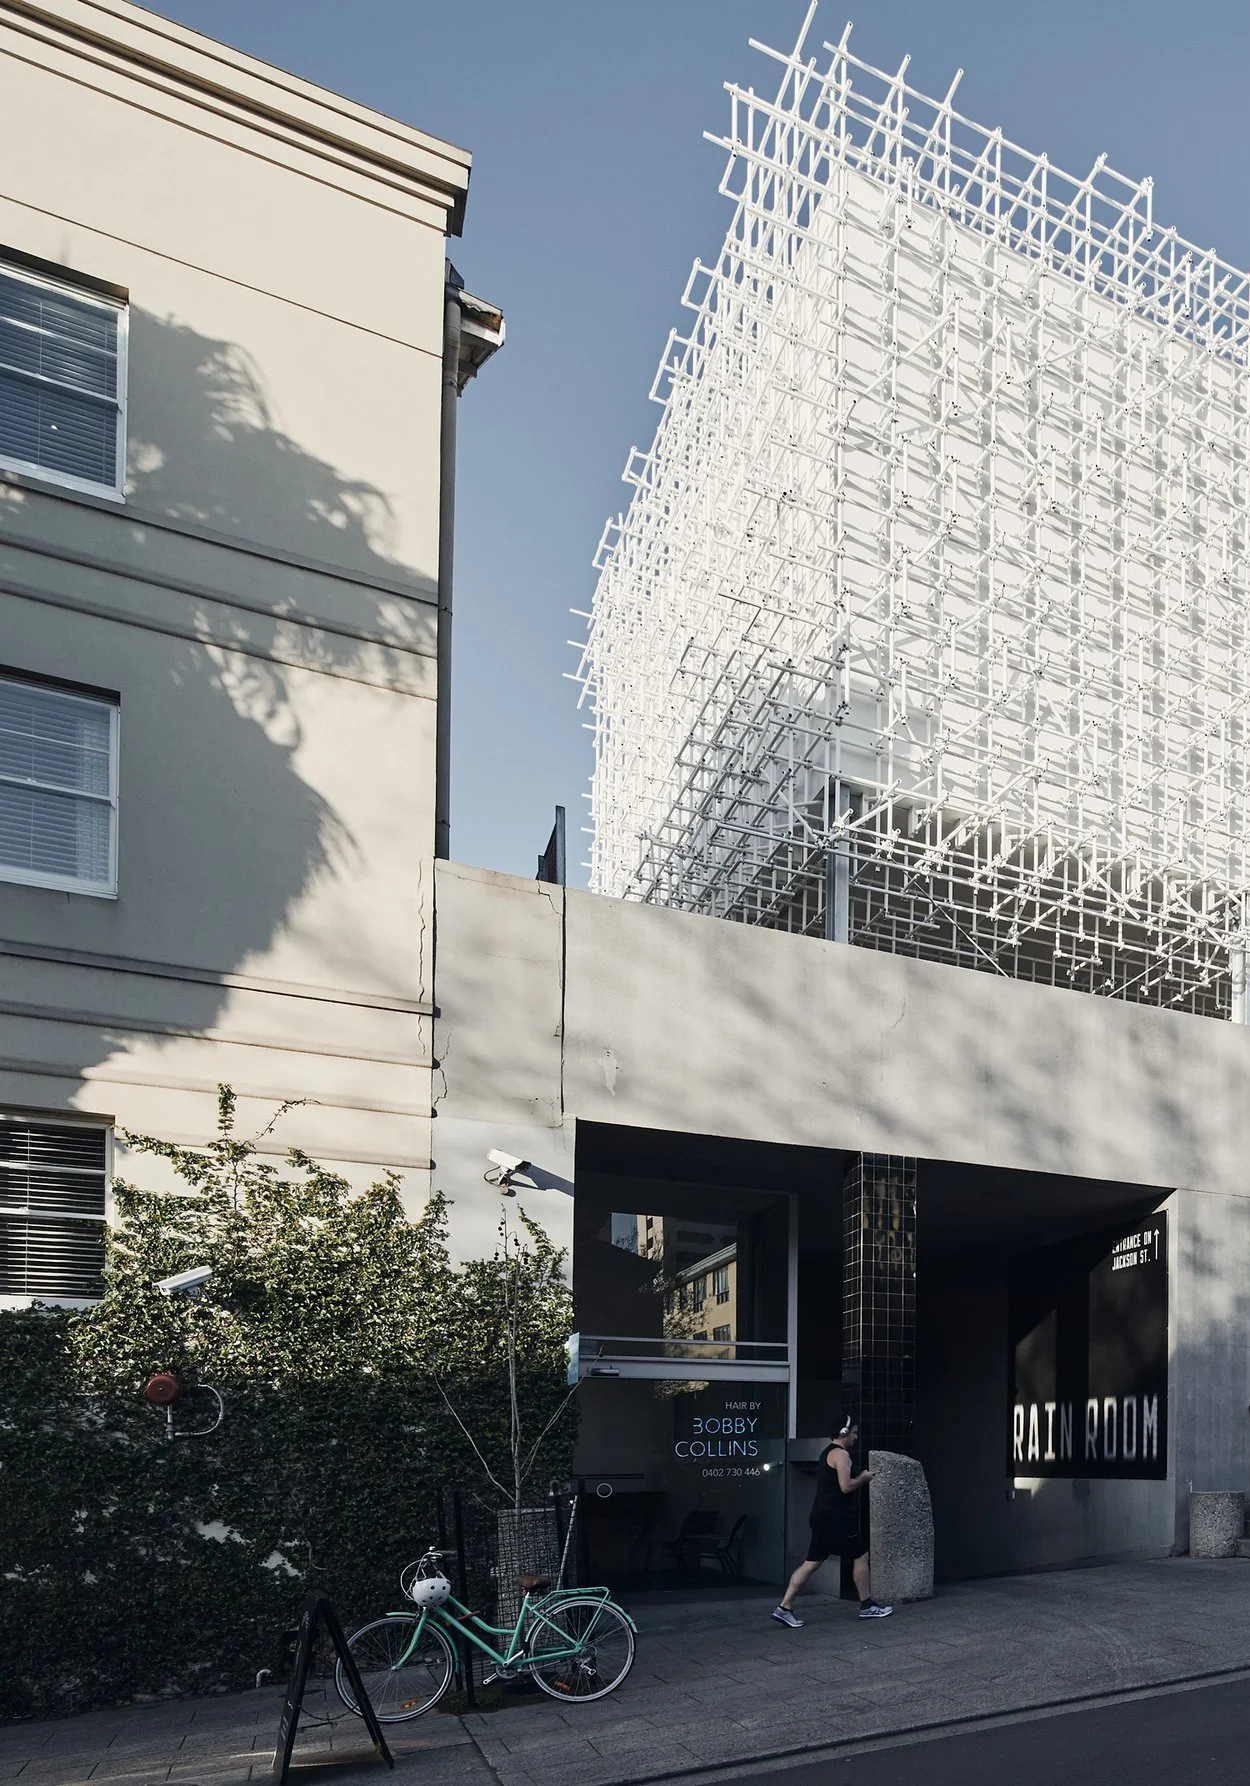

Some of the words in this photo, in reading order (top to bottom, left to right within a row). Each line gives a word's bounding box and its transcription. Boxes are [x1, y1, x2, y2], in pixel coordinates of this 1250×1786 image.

[1143, 1230, 1152, 1246] ON
[1112, 1251, 1138, 1270] JACKSON
[1139, 1249, 1151, 1264] ST.
[725, 1401, 747, 1410] HAIR
[749, 1401, 761, 1410] BY
[1013, 1401, 1073, 1462] RAIN
[1085, 1394, 1158, 1462] ROOM
[675, 1440, 758, 1458] COLLINS
[702, 1468, 724, 1477] 0402
[726, 1468, 742, 1477] 730
[744, 1468, 761, 1476] 446
